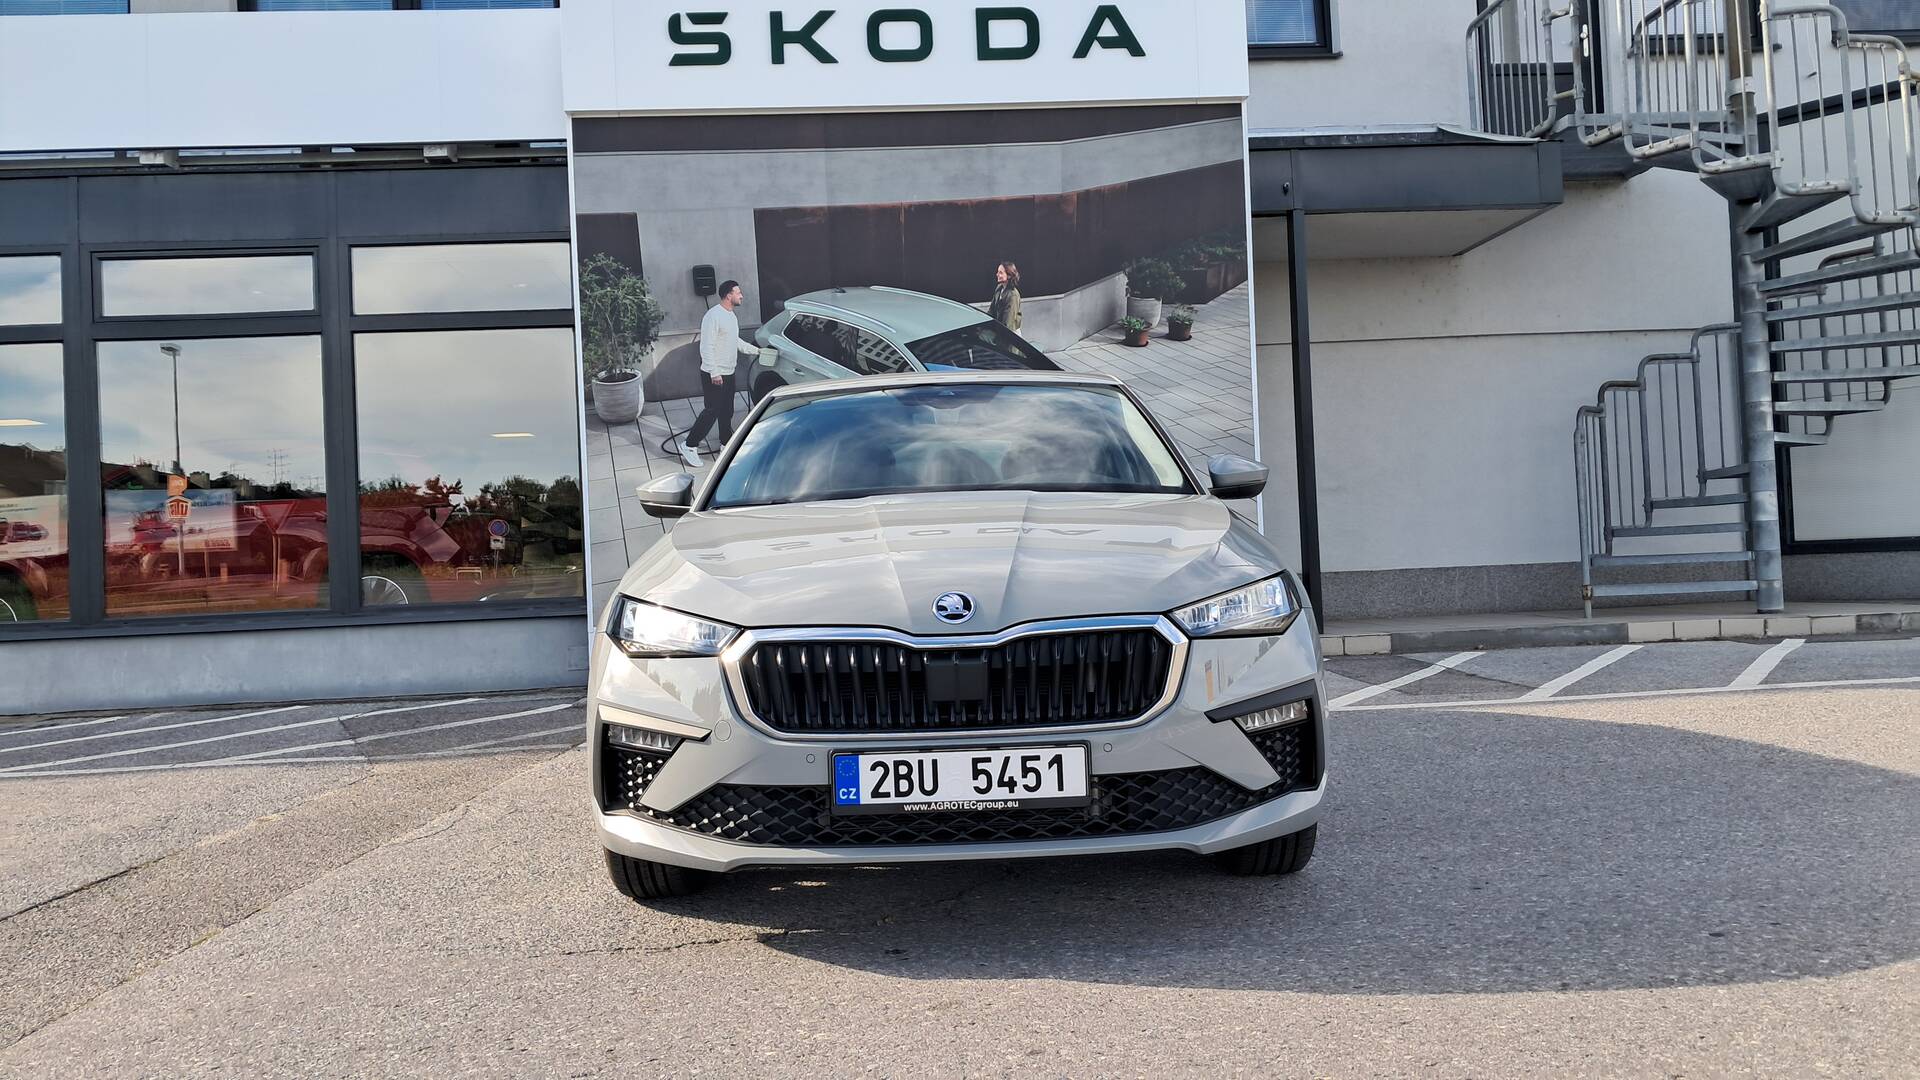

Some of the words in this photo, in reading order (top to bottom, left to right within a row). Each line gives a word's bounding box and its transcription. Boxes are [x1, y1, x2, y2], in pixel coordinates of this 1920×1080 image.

[869, 758, 939, 799] 2BU
[971, 753, 1065, 796] 5451
[839, 787, 857, 800] CZ
[903, 799, 1019, 812] www.AGROTECgroup.eu
